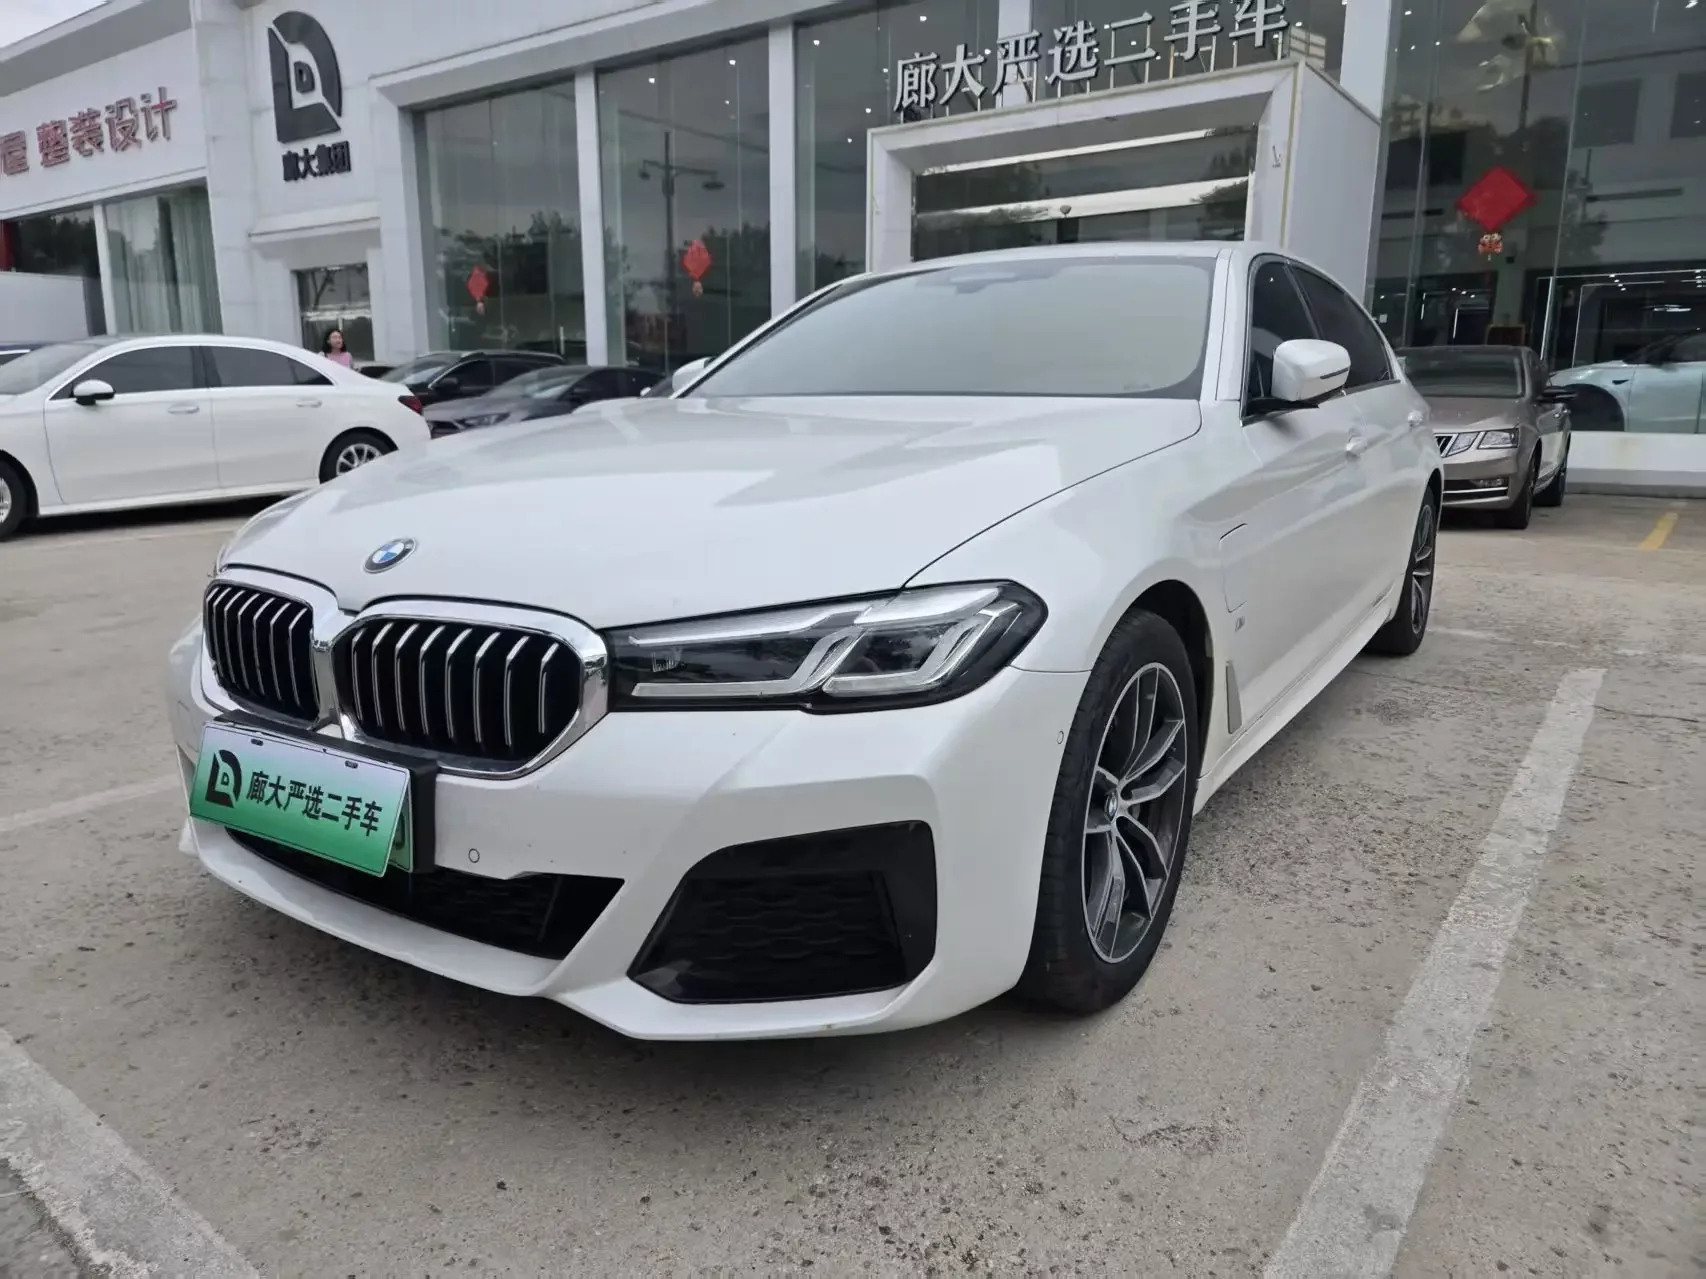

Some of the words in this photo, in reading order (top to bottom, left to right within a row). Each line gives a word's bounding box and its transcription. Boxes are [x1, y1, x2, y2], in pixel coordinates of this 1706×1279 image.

[893, 0, 1288, 112] 廊大严选二手车
[246, 770, 382, 837] 廊大严选二手车
